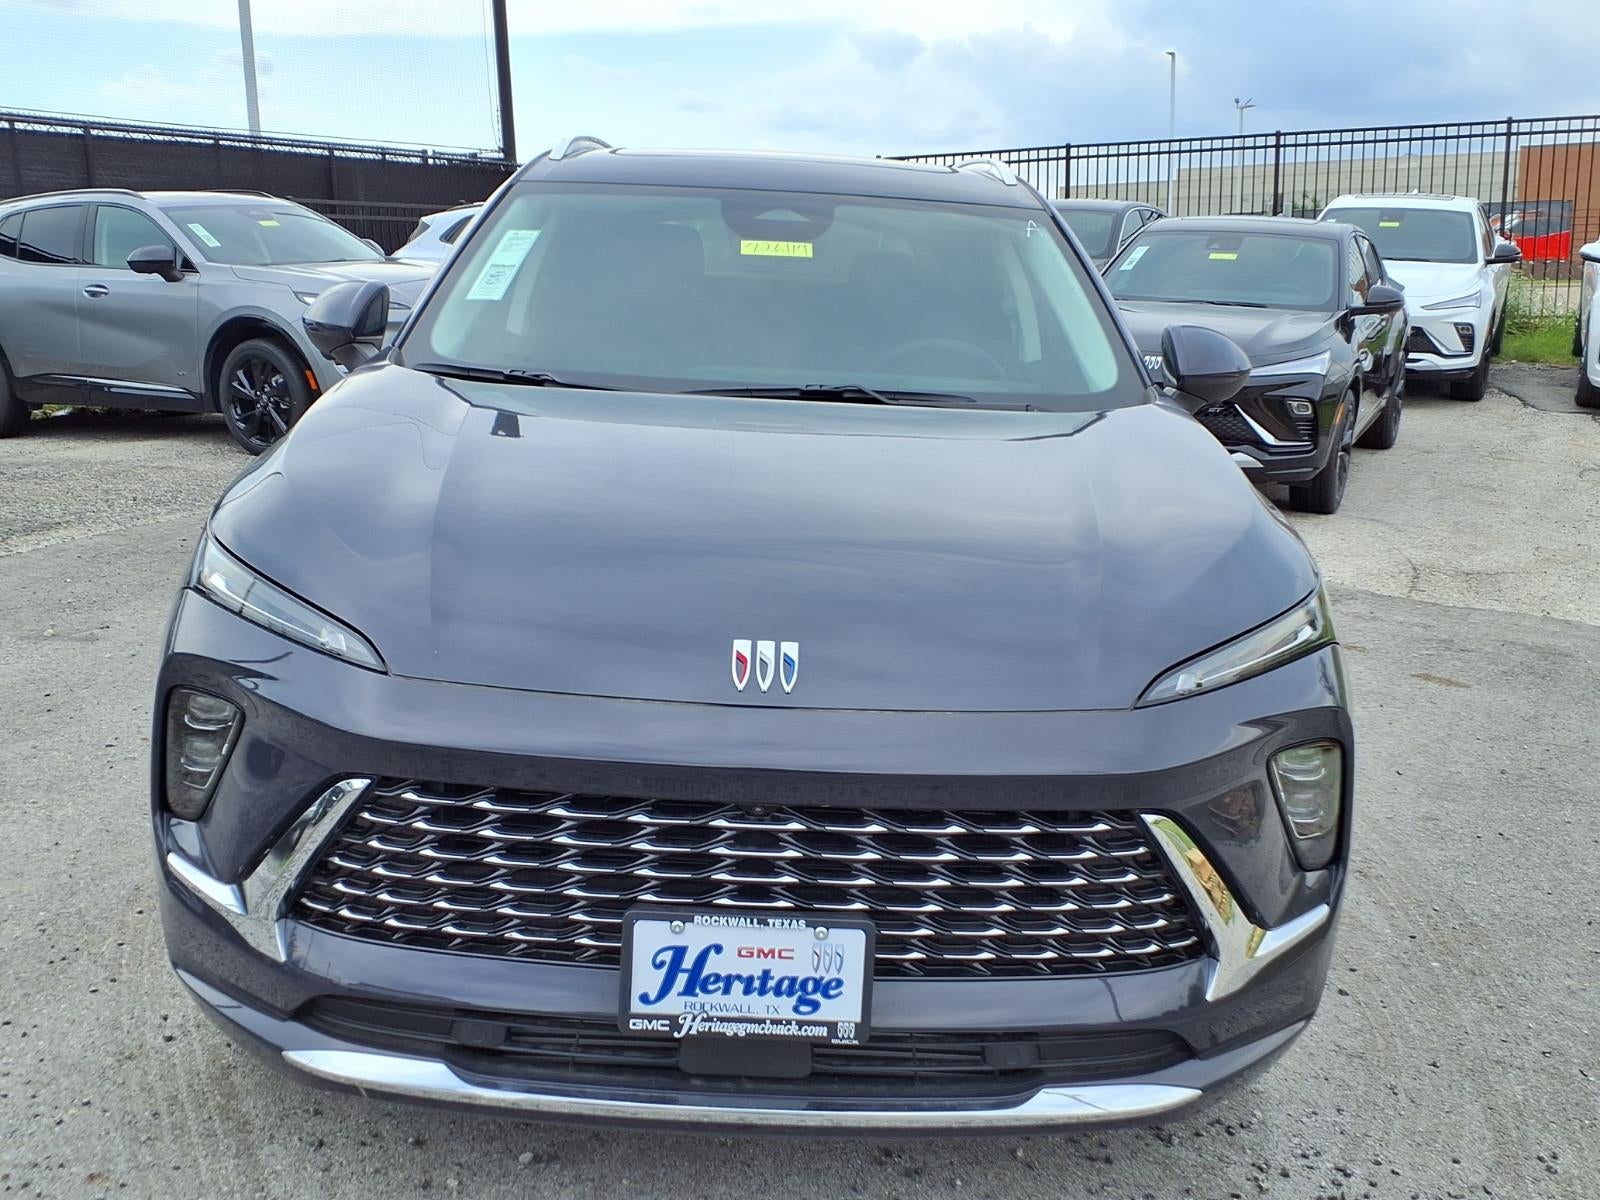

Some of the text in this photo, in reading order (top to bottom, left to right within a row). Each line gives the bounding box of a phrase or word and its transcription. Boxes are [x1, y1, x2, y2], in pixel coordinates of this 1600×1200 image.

[694, 915, 806, 929] ROCKWALL, TEXAS
[737, 946, 795, 960] GMC
[638, 943, 844, 1015] Heritage
[684, 1001, 780, 1015] ROCKWALL, TX
[629, 1018, 670, 1031] GMC
[673, 1012, 828, 1038] Heritagegmcbuick.com
